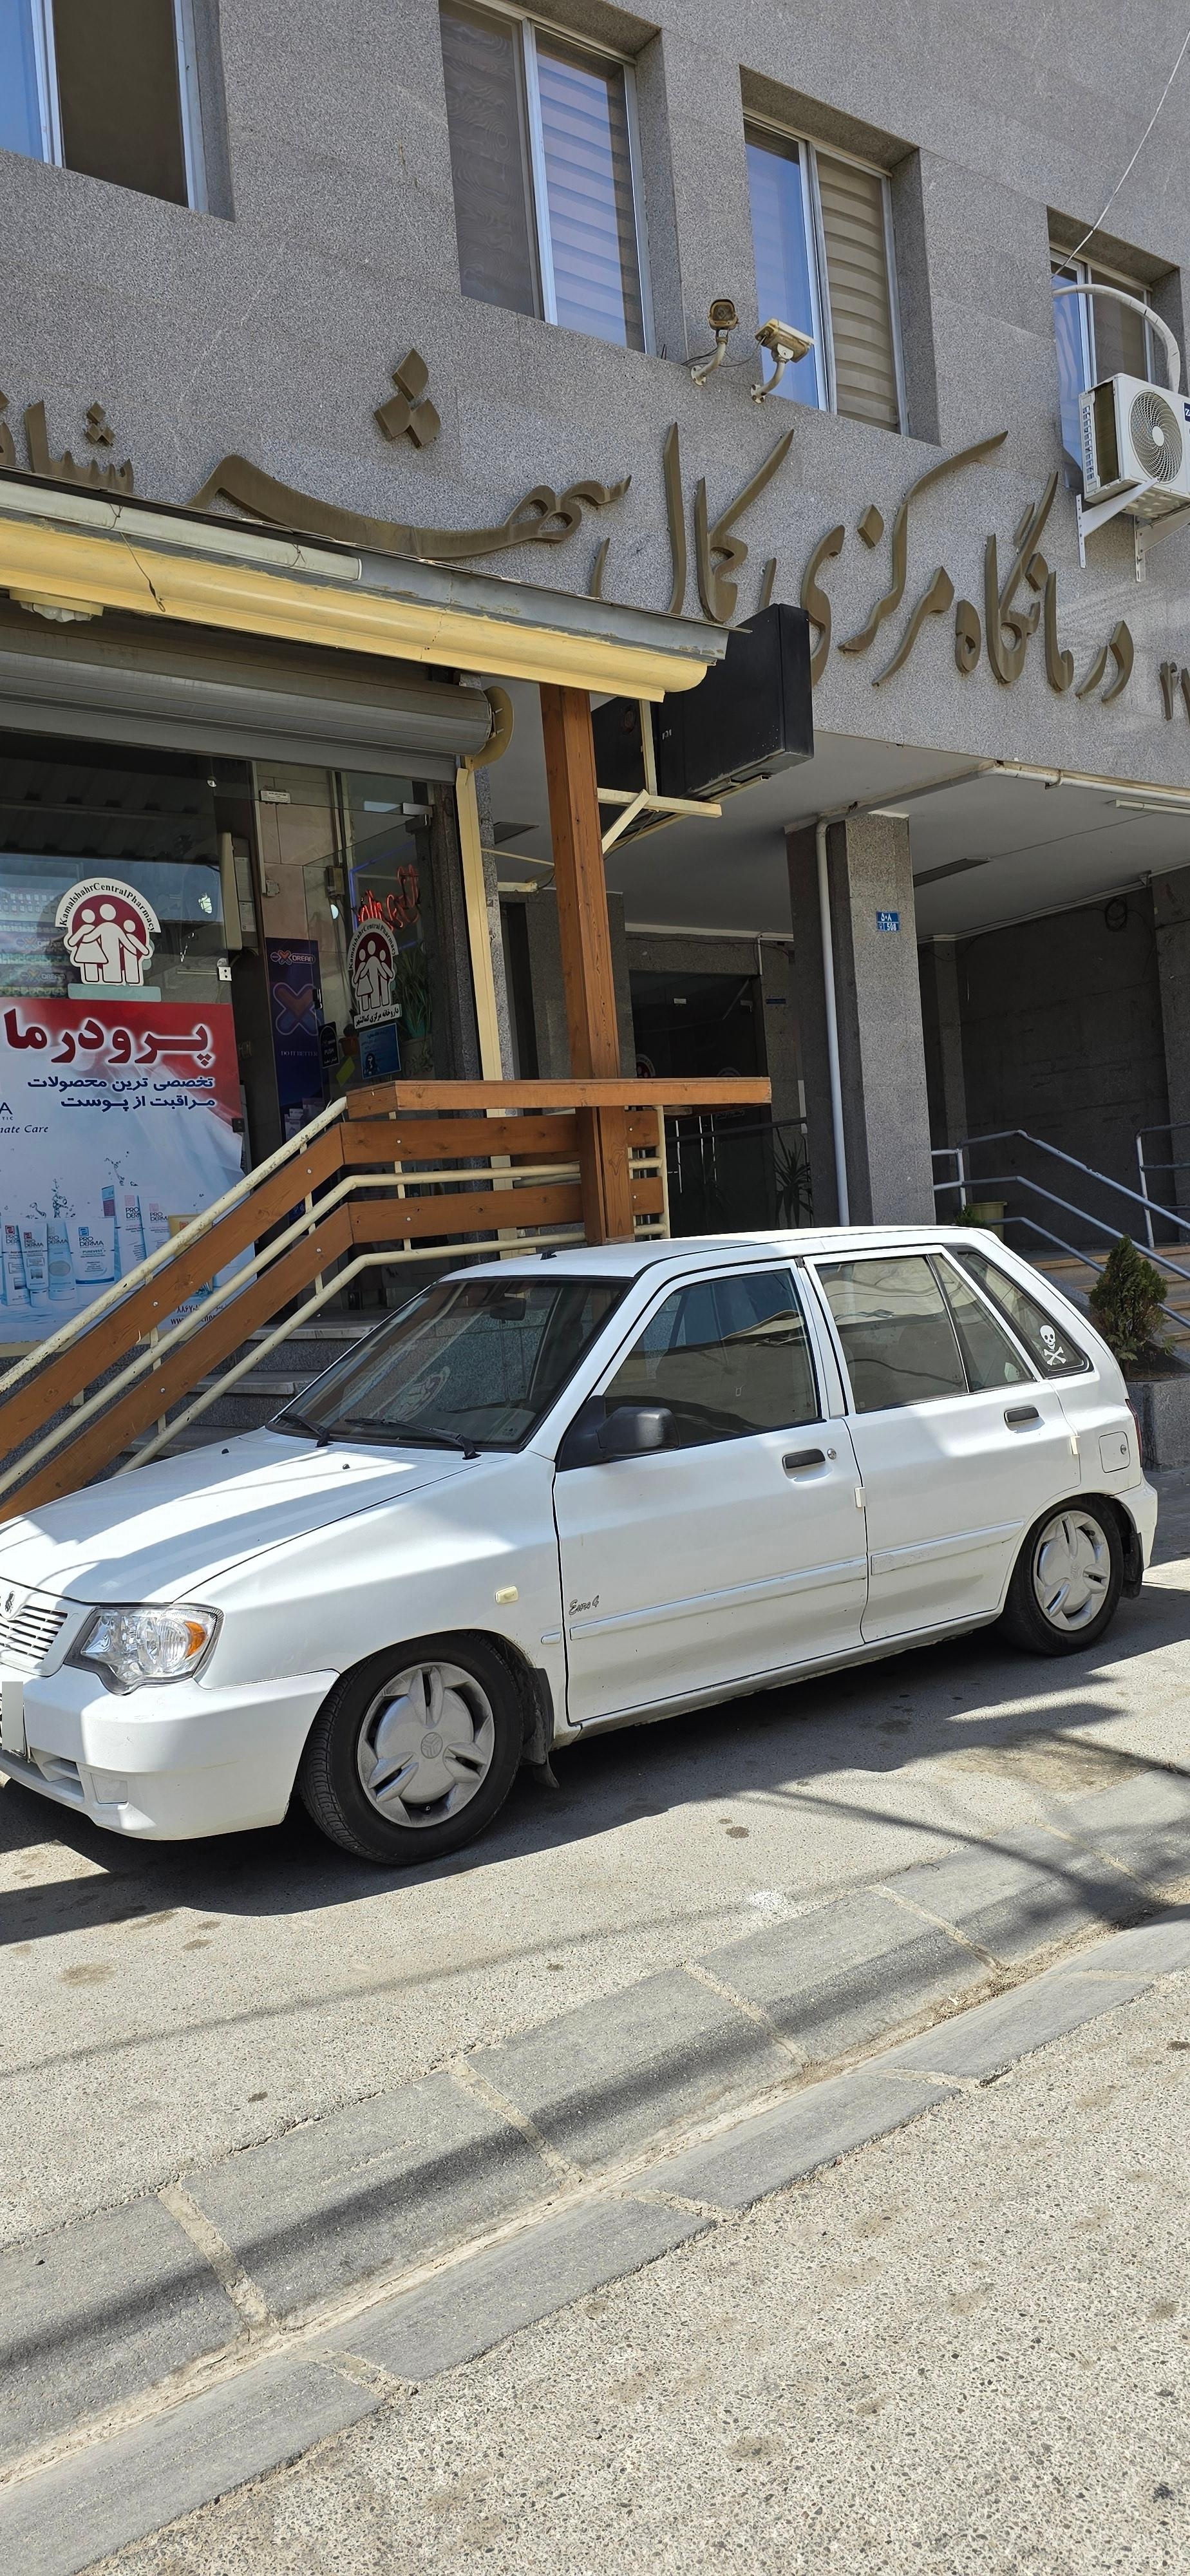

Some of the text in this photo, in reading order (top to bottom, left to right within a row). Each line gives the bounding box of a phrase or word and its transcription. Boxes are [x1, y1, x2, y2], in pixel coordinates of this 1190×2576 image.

[759, 429, 1010, 687] مرکزی
[954, 470, 1135, 705] درمانگاه
[880, 913, 892, 922] ۵۰۸
[886, 922, 897, 931] 508
[370, 1012, 382, 1023] مرکزی
[382, 1007, 399, 1018] داروخانه
[3, 1007, 212, 1067] پرودرما
[27, 1076, 214, 1094] تخصصی ترین محصولات
[61, 1095, 216, 1113] مراقبت از پوست
[24, 1124, 49, 1133] Care
[568, 1595, 600, 1616] Euro 4
